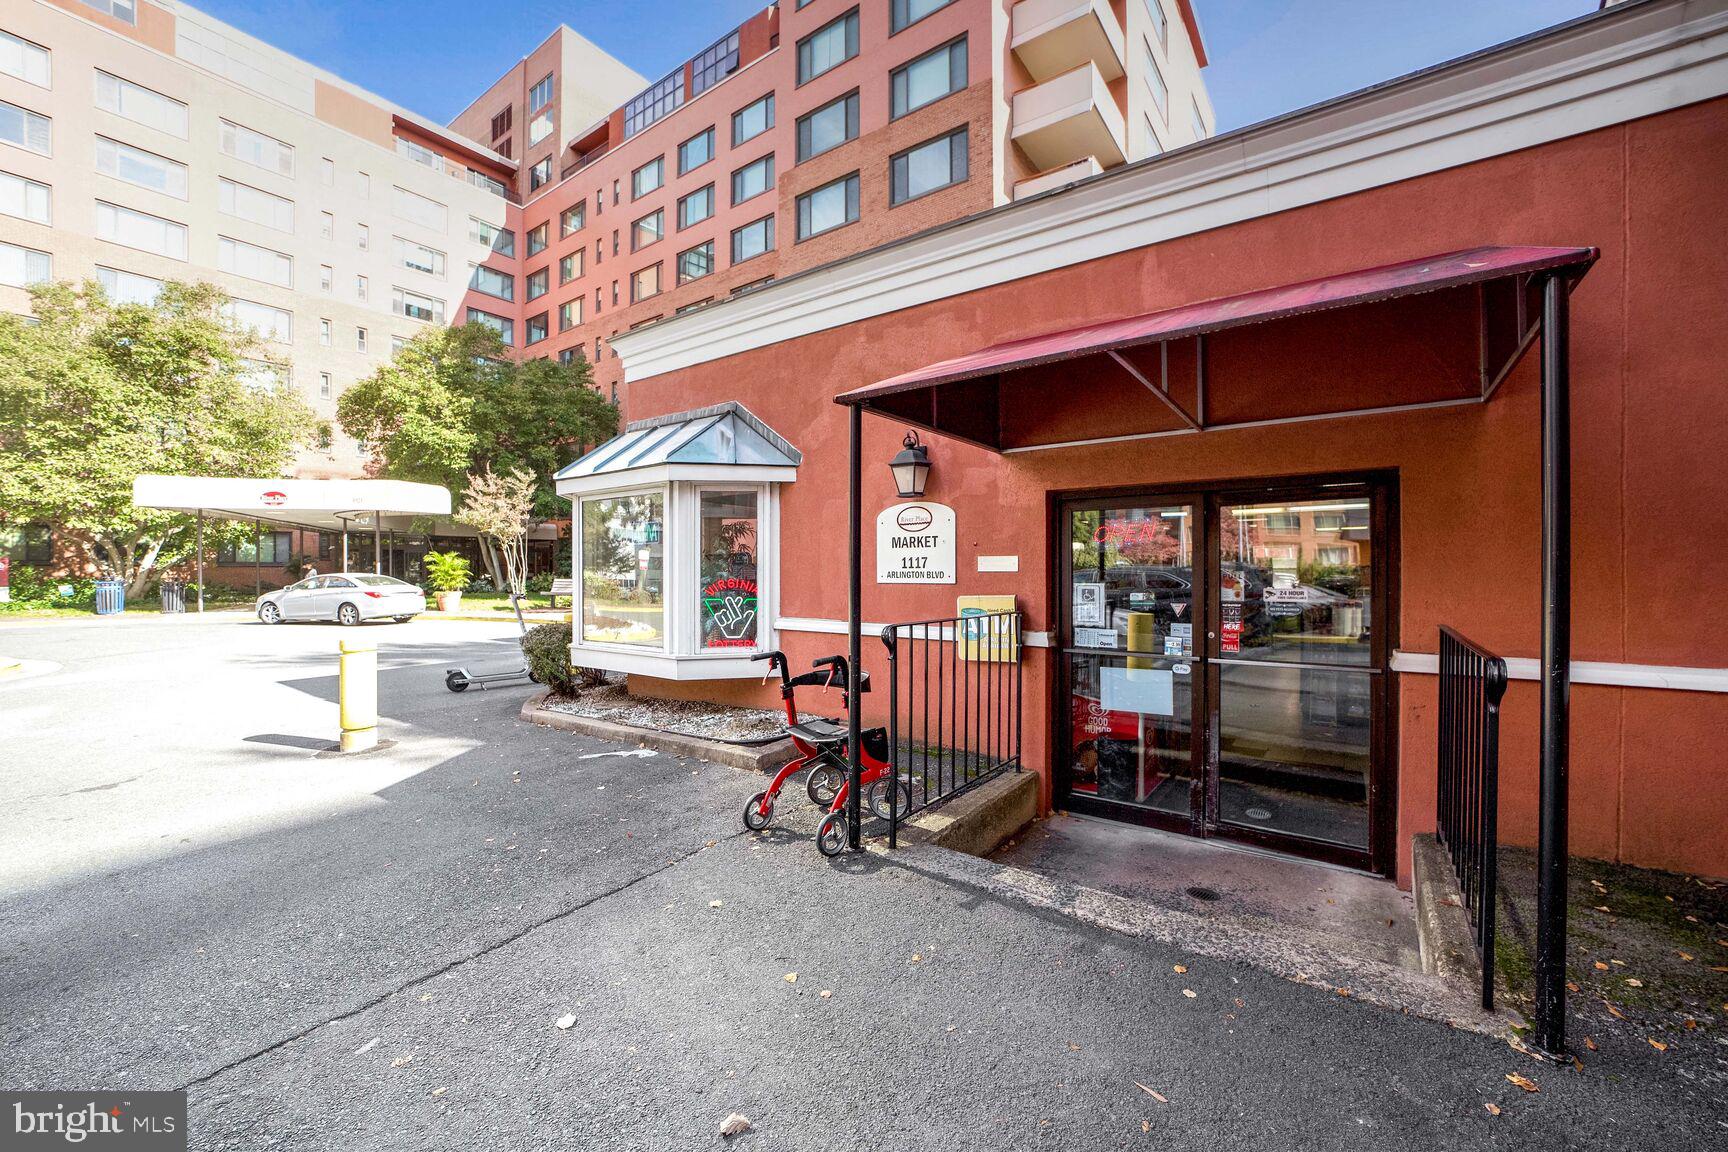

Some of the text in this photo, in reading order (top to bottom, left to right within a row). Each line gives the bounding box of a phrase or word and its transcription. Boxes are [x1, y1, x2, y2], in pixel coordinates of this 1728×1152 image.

[1093, 521, 1157, 543] OPEN
[891, 536, 938, 548] MARKET
[901, 556, 928, 569] 1117
[886, 571, 945, 579] ARLINGTON BLVD
[704, 578, 758, 596] VIRGINIA
[962, 615, 1015, 635] ATM
[707, 639, 758, 648] LOTTERY
[1222, 643, 1238, 651] PULL
[1088, 716, 1109, 727] GOOD
